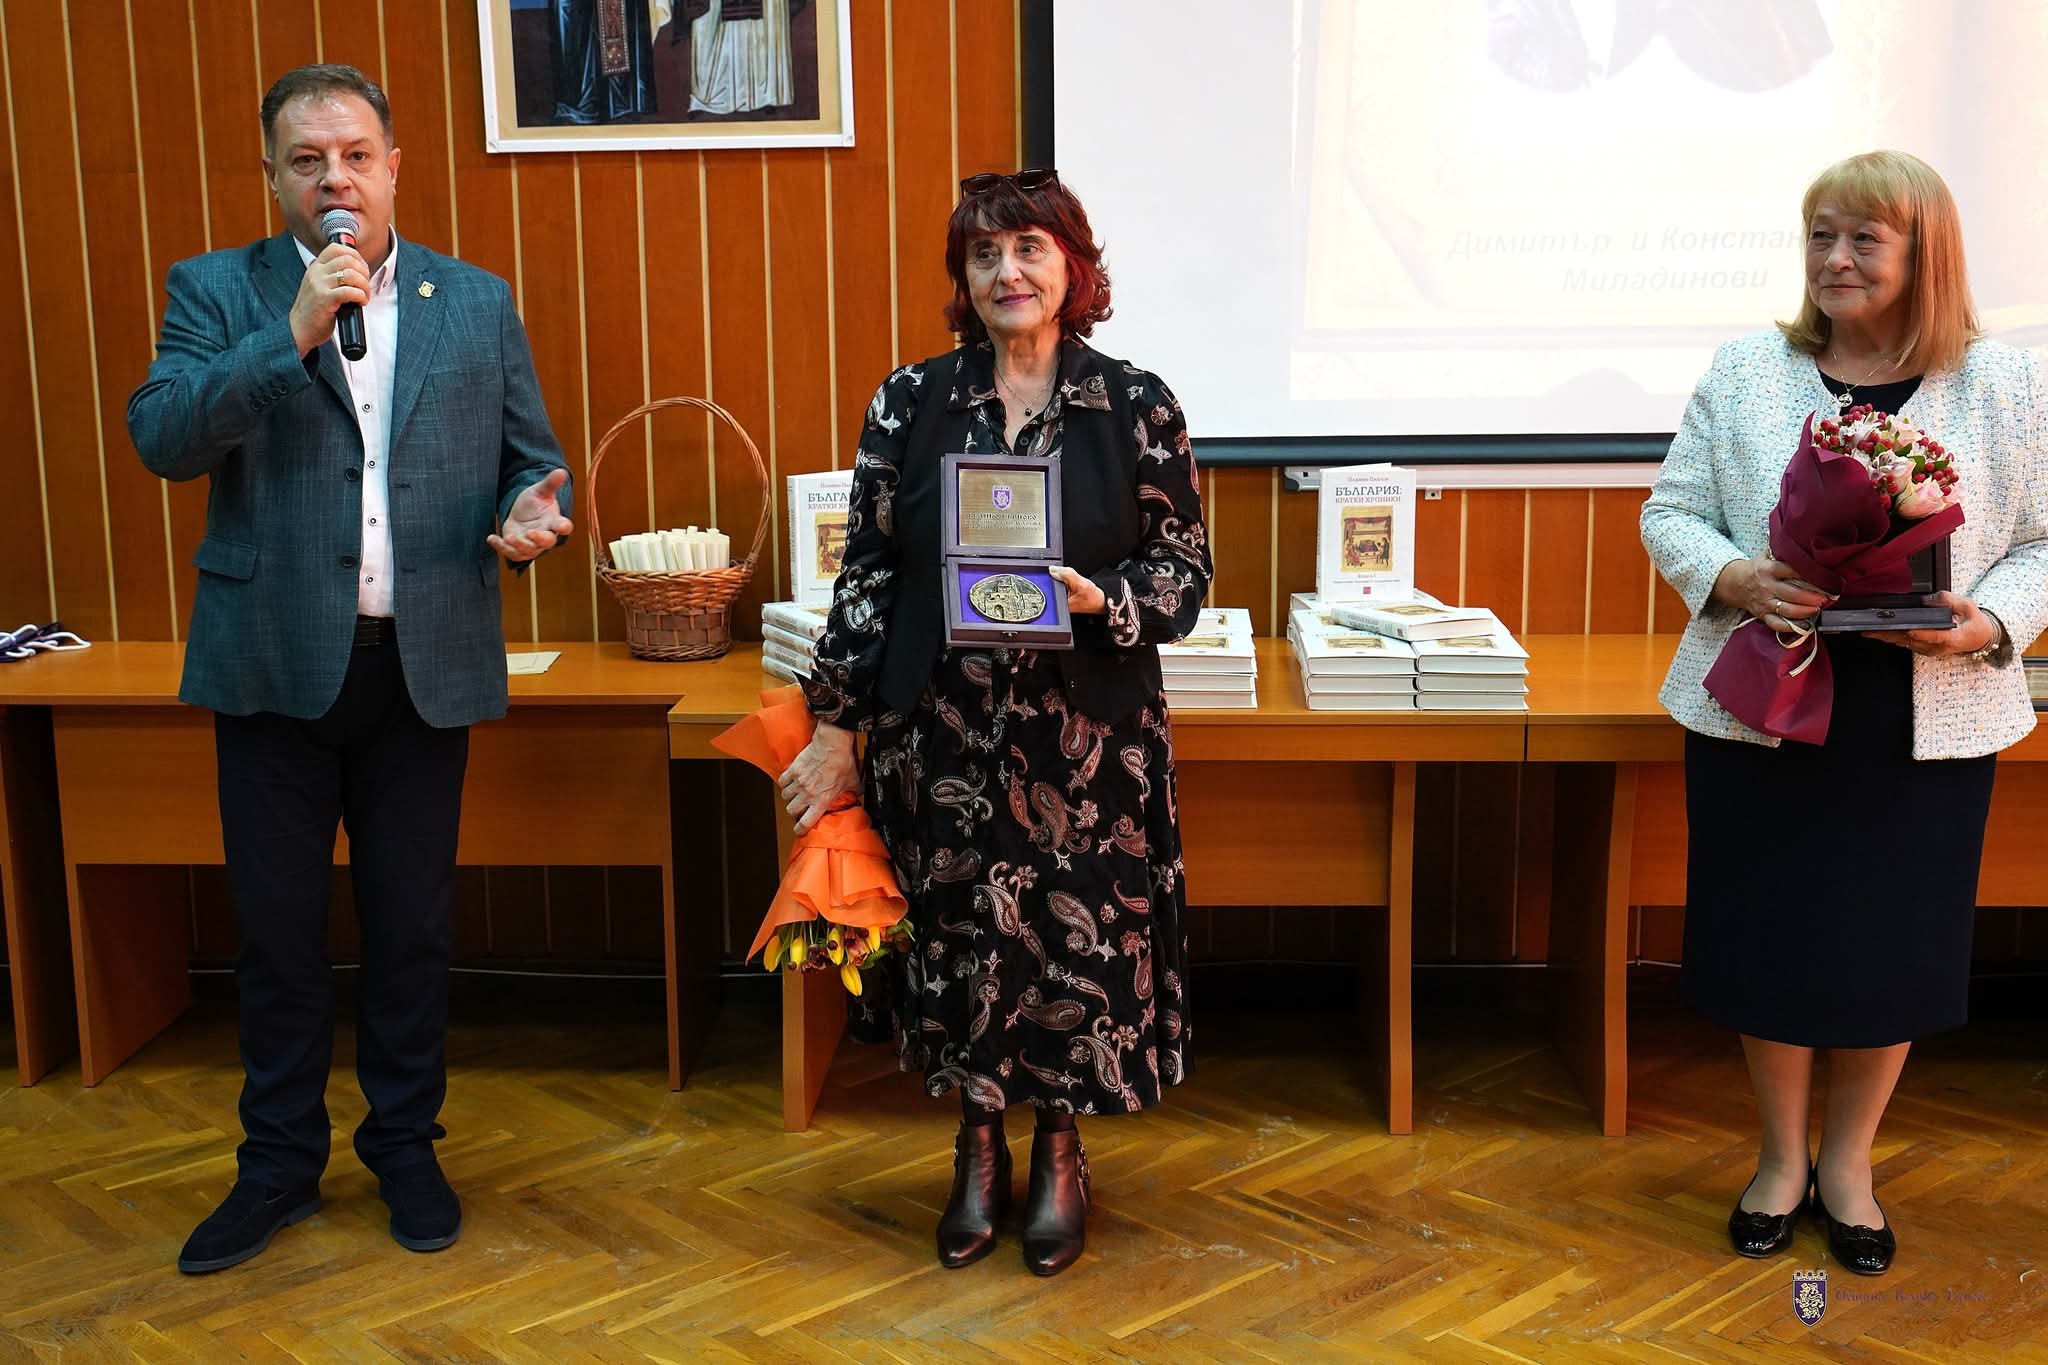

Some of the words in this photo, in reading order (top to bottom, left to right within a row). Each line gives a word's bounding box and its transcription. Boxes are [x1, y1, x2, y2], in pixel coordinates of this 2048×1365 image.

[1447, 230, 1610, 260] Димитър
[1631, 232, 1649, 251] и
[1659, 225, 1800, 252] Констан
[1561, 266, 1769, 293] Миладинови
[808, 492, 850, 503] БЪЛГА
